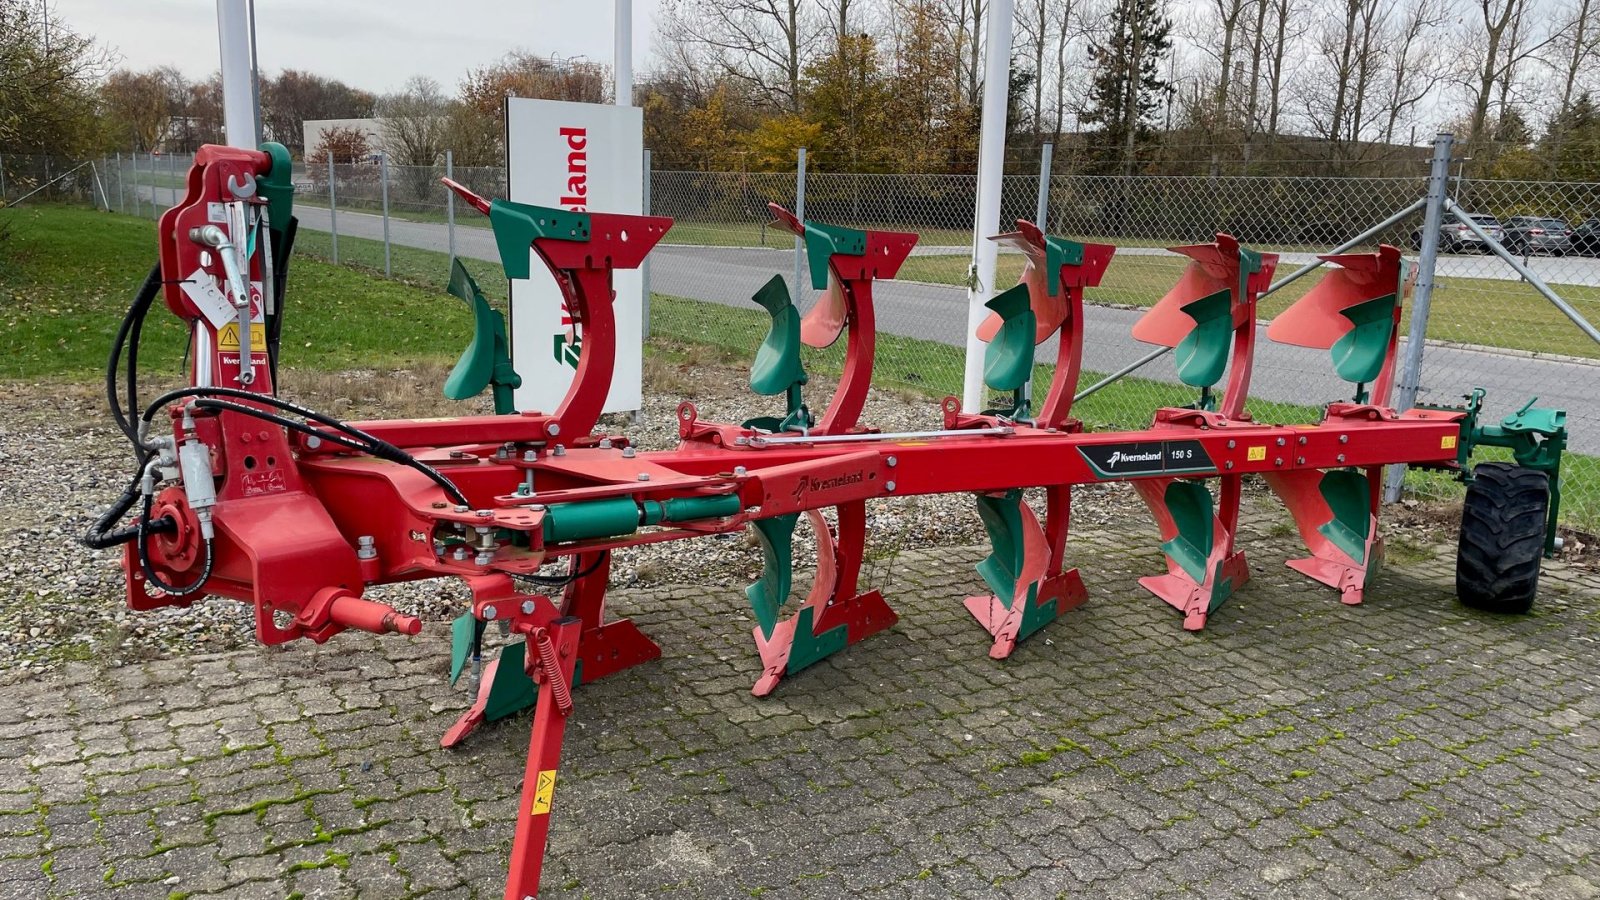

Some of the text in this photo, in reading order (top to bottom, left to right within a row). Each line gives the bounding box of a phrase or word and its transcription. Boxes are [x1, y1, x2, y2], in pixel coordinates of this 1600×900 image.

[1121, 450, 1192, 463] Kverneland 150 S
[810, 470, 864, 492] Kverneland
